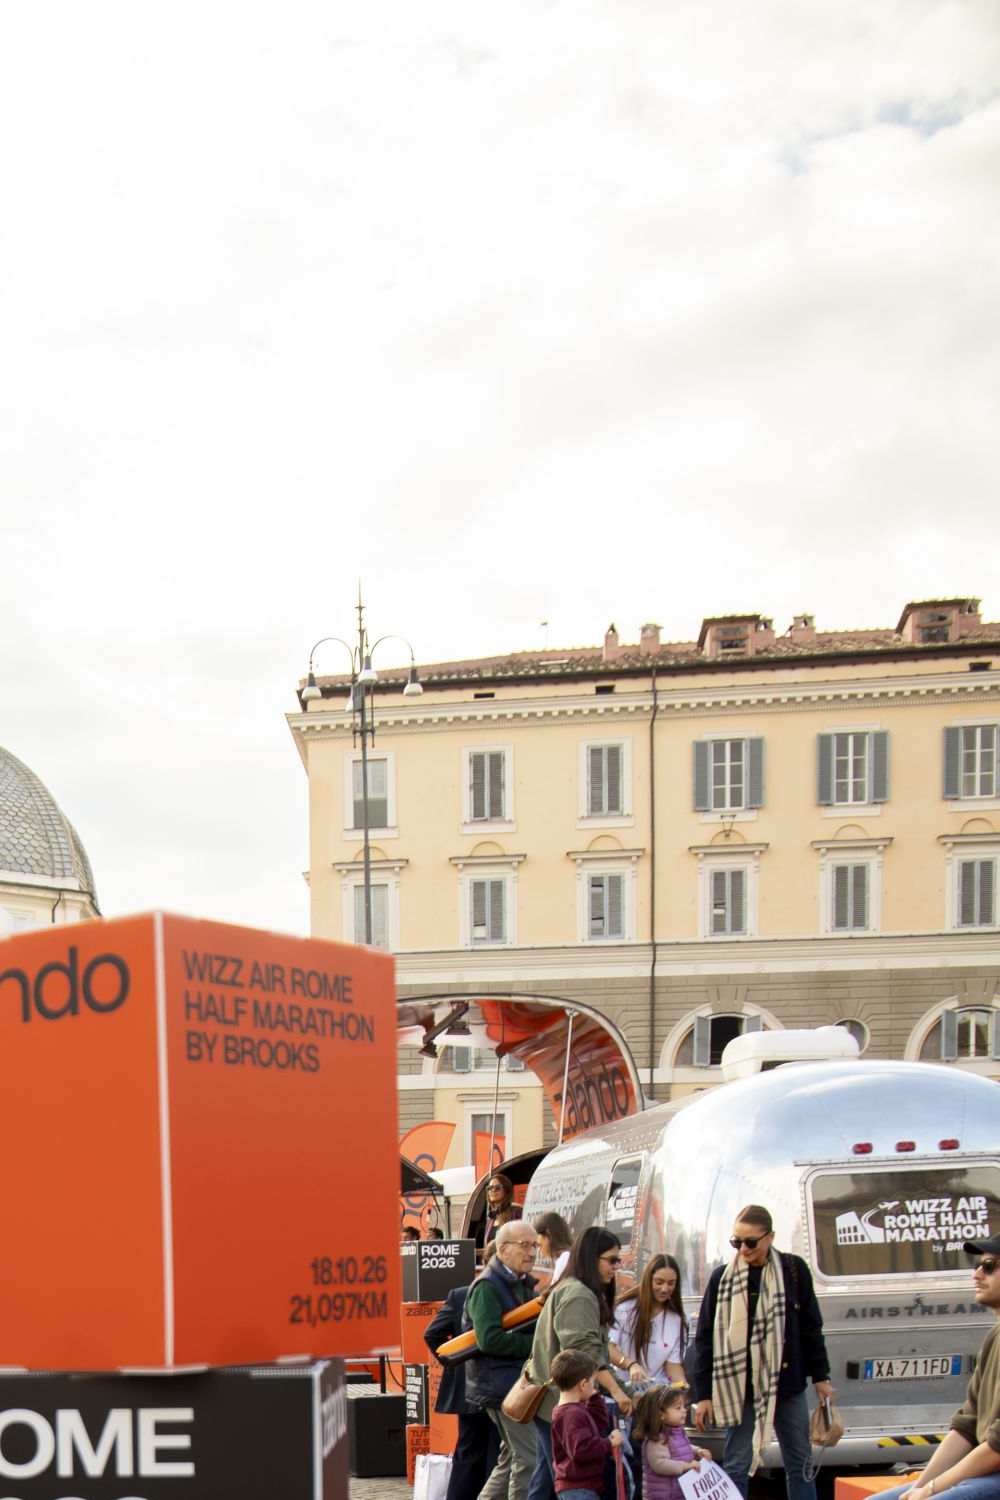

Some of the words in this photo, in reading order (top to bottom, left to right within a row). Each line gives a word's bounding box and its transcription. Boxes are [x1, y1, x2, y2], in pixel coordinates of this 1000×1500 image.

[183, 949, 244, 988] WIZZ
[250, 960, 286, 994] AIR
[291, 966, 353, 1004] ROME
[185, 989, 248, 1026] HALF
[253, 998, 375, 1042] MARATHON
[186, 1030, 218, 1063] BY
[223, 1033, 320, 1073] BROOKS
[905, 1198, 953, 1214] WIZZ
[957, 1196, 988, 1211] AIR
[884, 1212, 937, 1229] ROME
[940, 1210, 988, 1226] HALF
[885, 1224, 990, 1242] MARATHON
[421, 1244, 460, 1256] ROME
[932, 1243, 943, 1253] by
[311, 1255, 387, 1285] 18.10.26
[421, 1257, 456, 1269] 2026
[289, 1291, 387, 1328] 21,097KM
[406, 1305, 438, 1317] zalan
[845, 1303, 987, 1319] AIRSTREAM
[692, 1466, 722, 1498] FORZA
